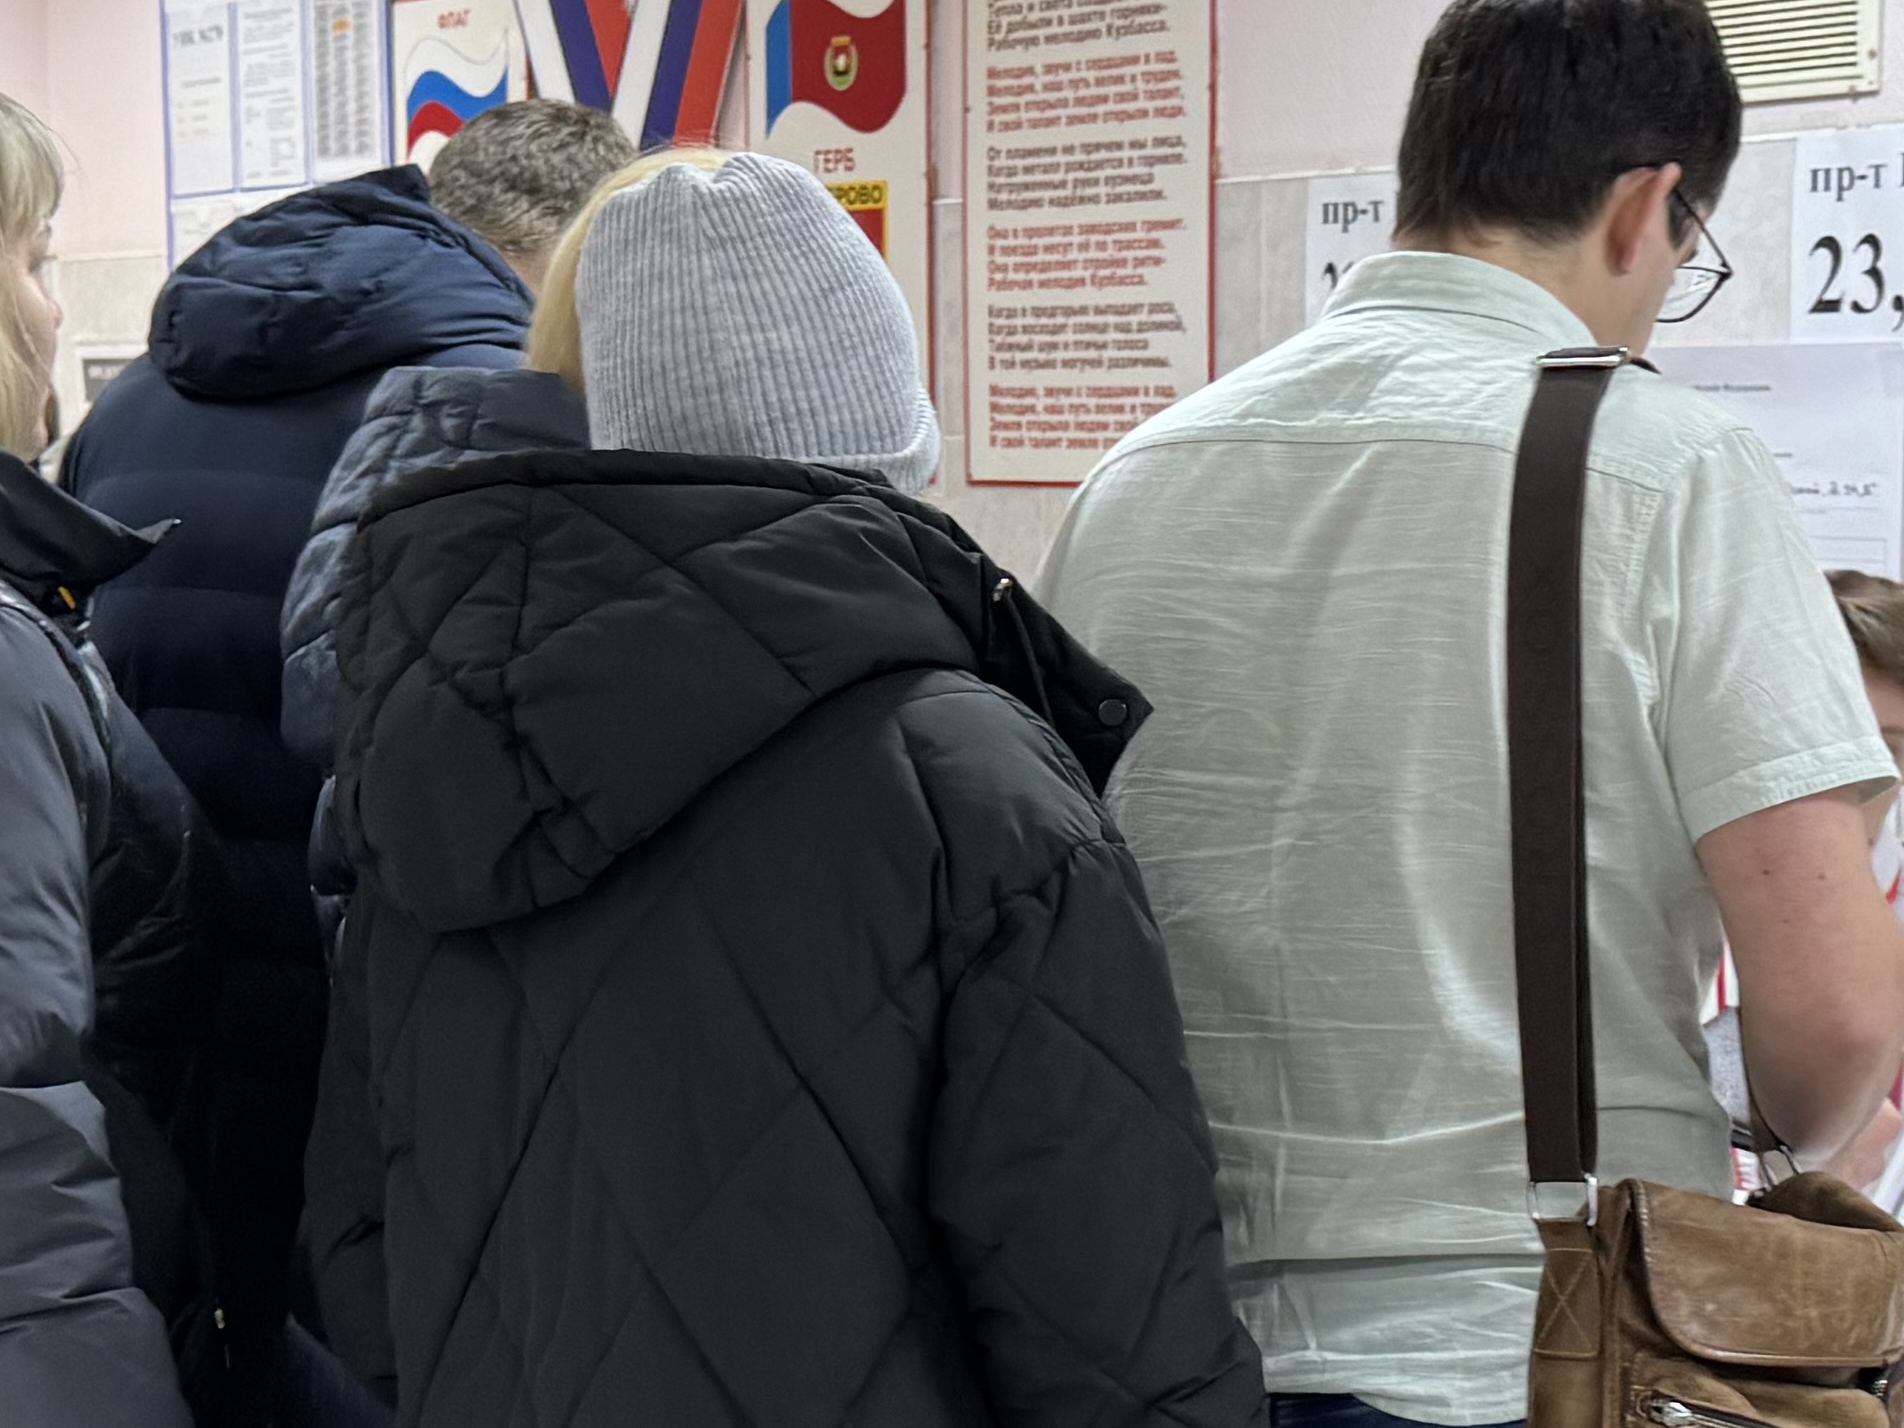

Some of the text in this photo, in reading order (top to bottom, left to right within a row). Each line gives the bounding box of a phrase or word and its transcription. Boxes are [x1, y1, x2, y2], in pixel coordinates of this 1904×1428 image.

[437, 9, 472, 31] ФЛАГ
[813, 147, 856, 174] ГЕРБ
[1809, 161, 1890, 203] пр-т
[1321, 199, 1386, 234] пр-т
